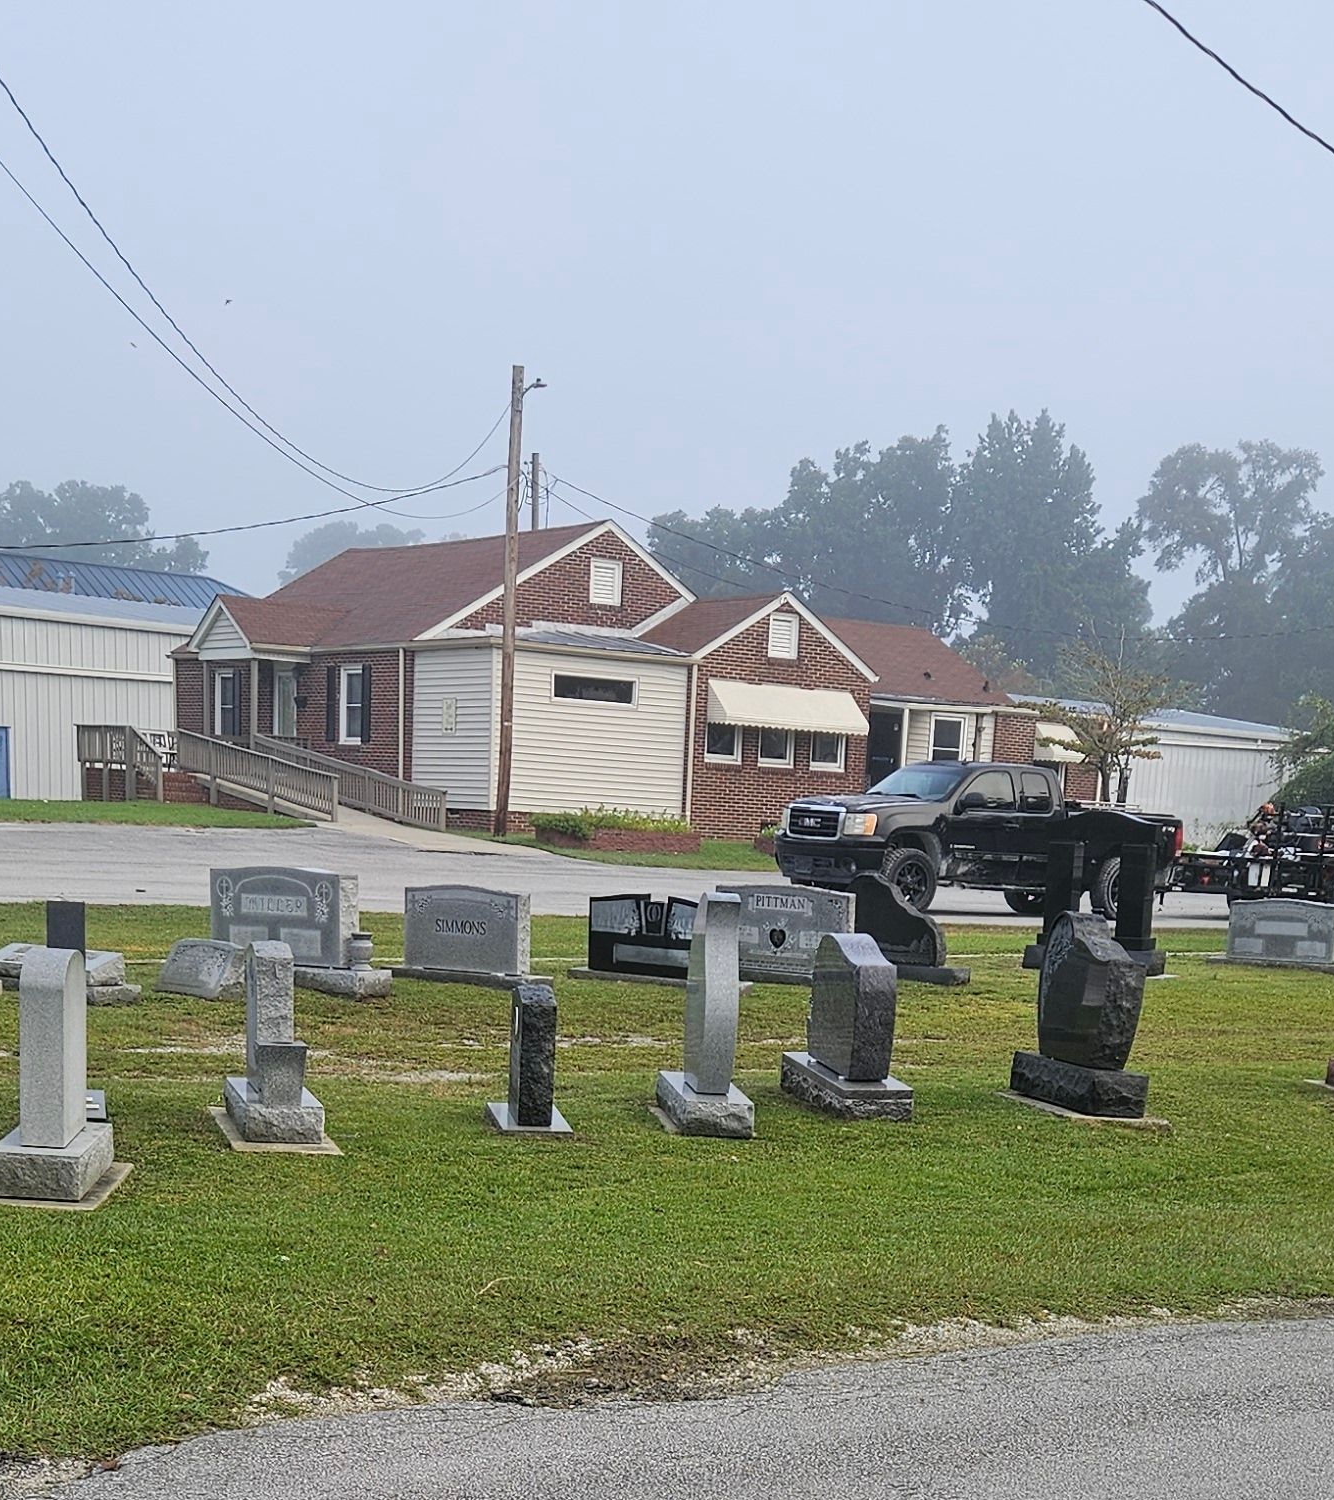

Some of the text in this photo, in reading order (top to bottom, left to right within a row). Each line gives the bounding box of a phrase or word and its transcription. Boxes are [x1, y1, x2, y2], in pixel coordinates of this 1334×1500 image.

[798, 816, 822, 828] GMC
[247, 897, 303, 913] MILLER
[756, 895, 806, 910] PITTMAN
[435, 918, 487, 936] SIMMONS
